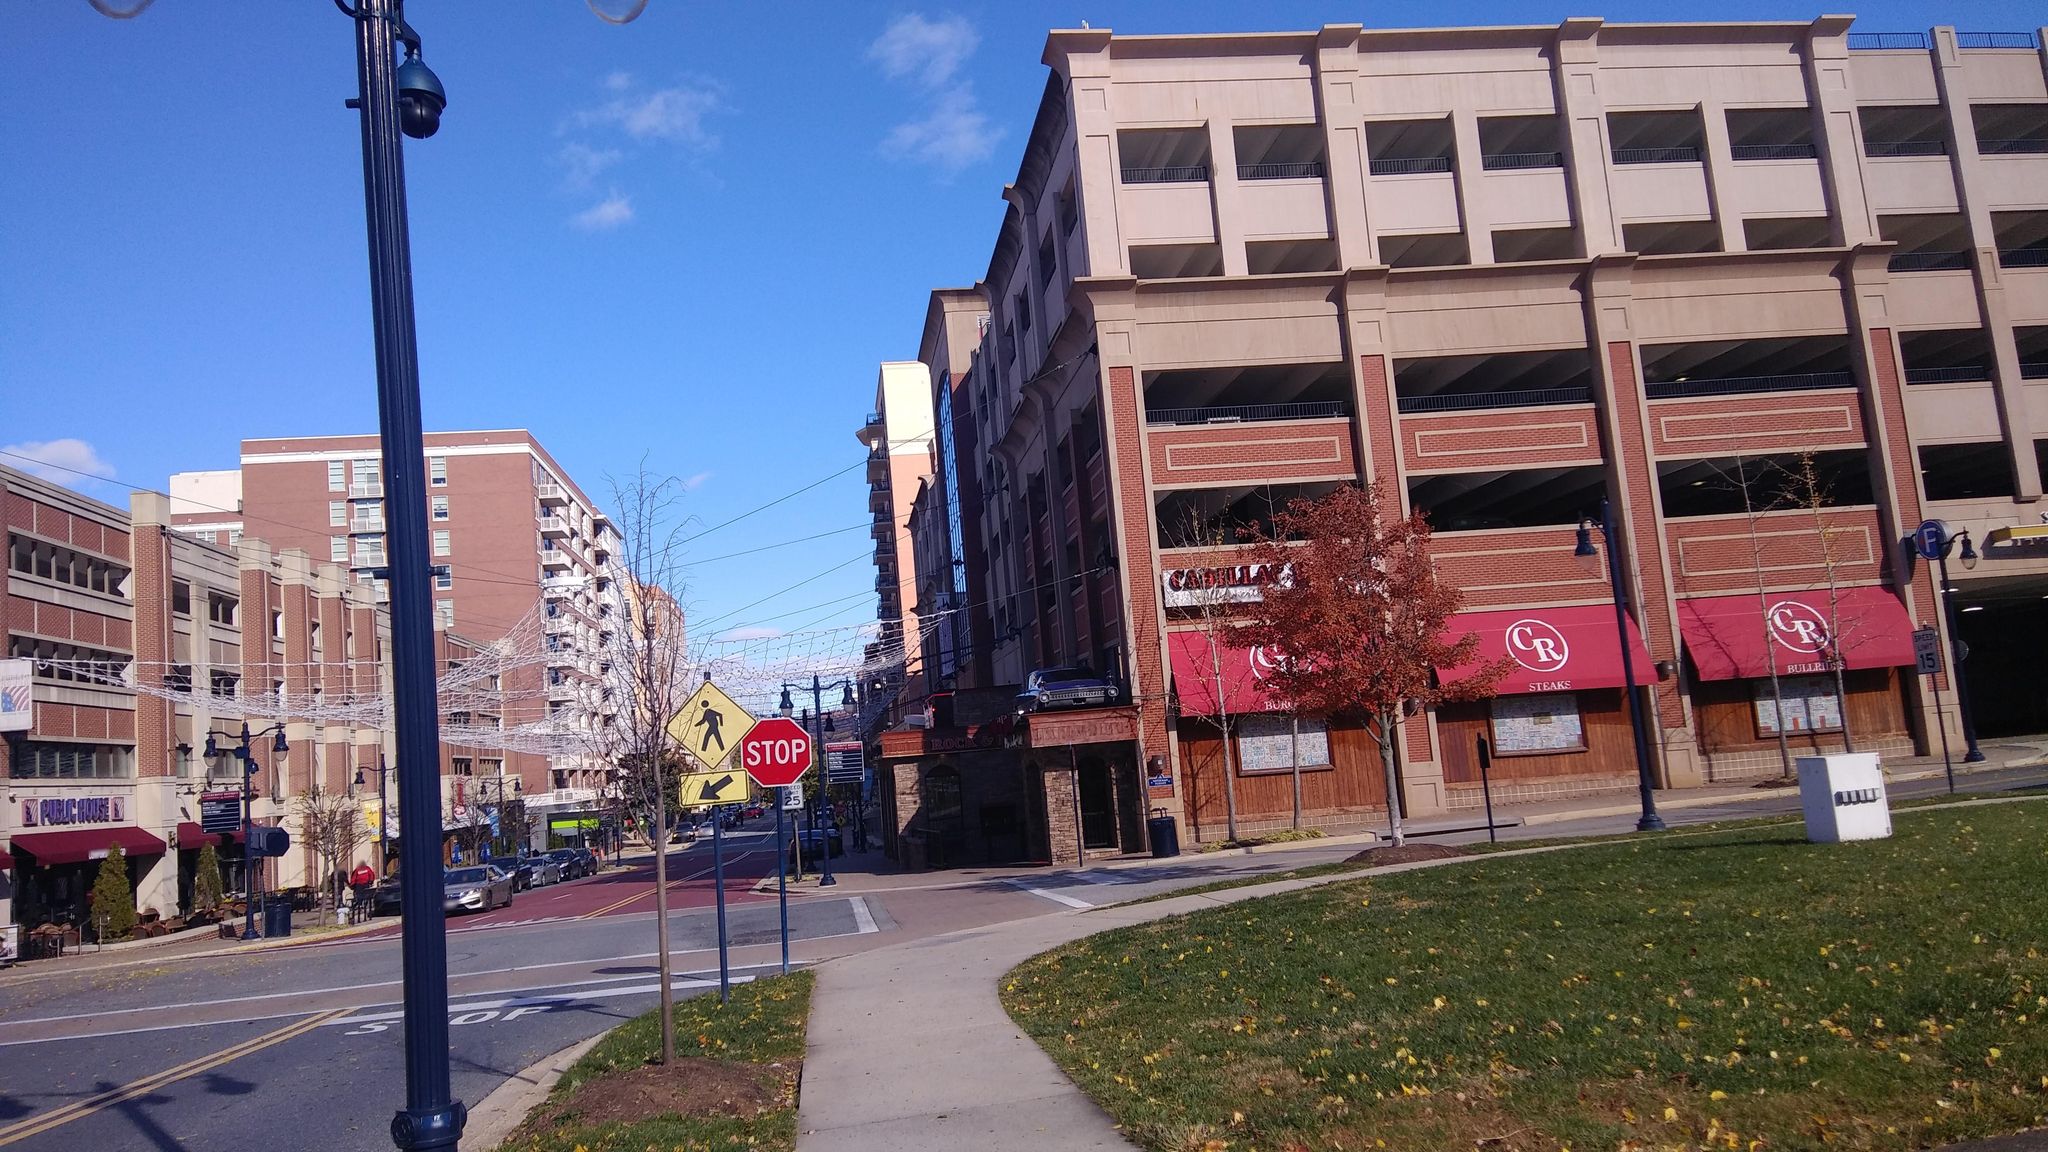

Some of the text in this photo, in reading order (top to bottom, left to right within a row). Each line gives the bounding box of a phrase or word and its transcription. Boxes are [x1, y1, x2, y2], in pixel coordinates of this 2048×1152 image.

[1914, 633, 1935, 642] SPEED
[1920, 652, 1936, 669] 15
[1528, 680, 1572, 692] STEAKS
[746, 739, 807, 767] STOP
[784, 796, 801, 807] 25
[40, 796, 110, 826] PUBLIC HOUSE
[344, 1006, 553, 1036] SOP
